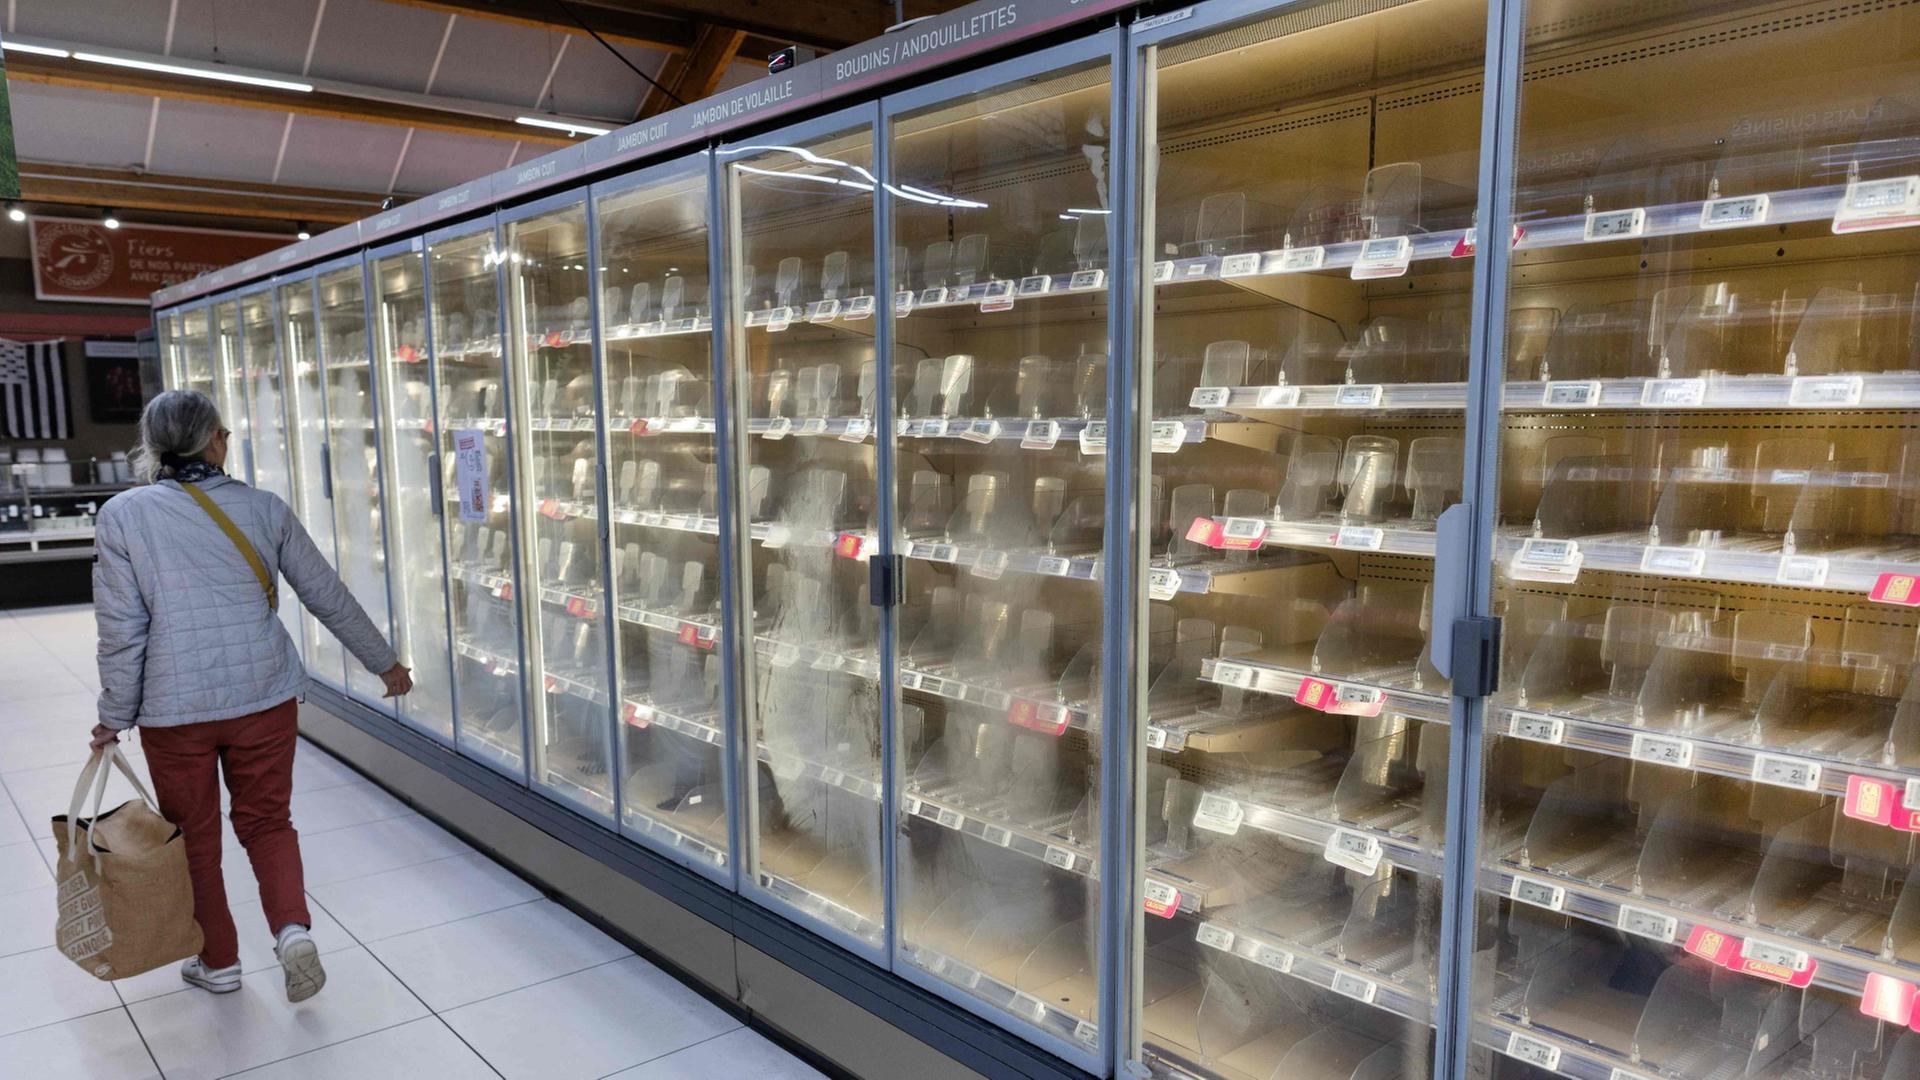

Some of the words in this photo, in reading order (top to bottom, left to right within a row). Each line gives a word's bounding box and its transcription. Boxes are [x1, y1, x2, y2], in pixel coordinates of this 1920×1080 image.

[836, 47, 890, 81] BOUDINS
[893, 42, 899, 63] /
[901, 4, 1017, 60] ANDOUILLETTES
[691, 102, 729, 129] JAMBON
[731, 97, 743, 116] DE
[745, 80, 792, 109] VOLAILLE
[617, 130, 648, 152] JAMBON
[650, 122, 669, 141] CUIT
[517, 168, 541, 185] JAMBON
[127, 239, 174, 257] Fiers
[129, 258, 144, 270] DE
[147, 260, 171, 272] NOS
